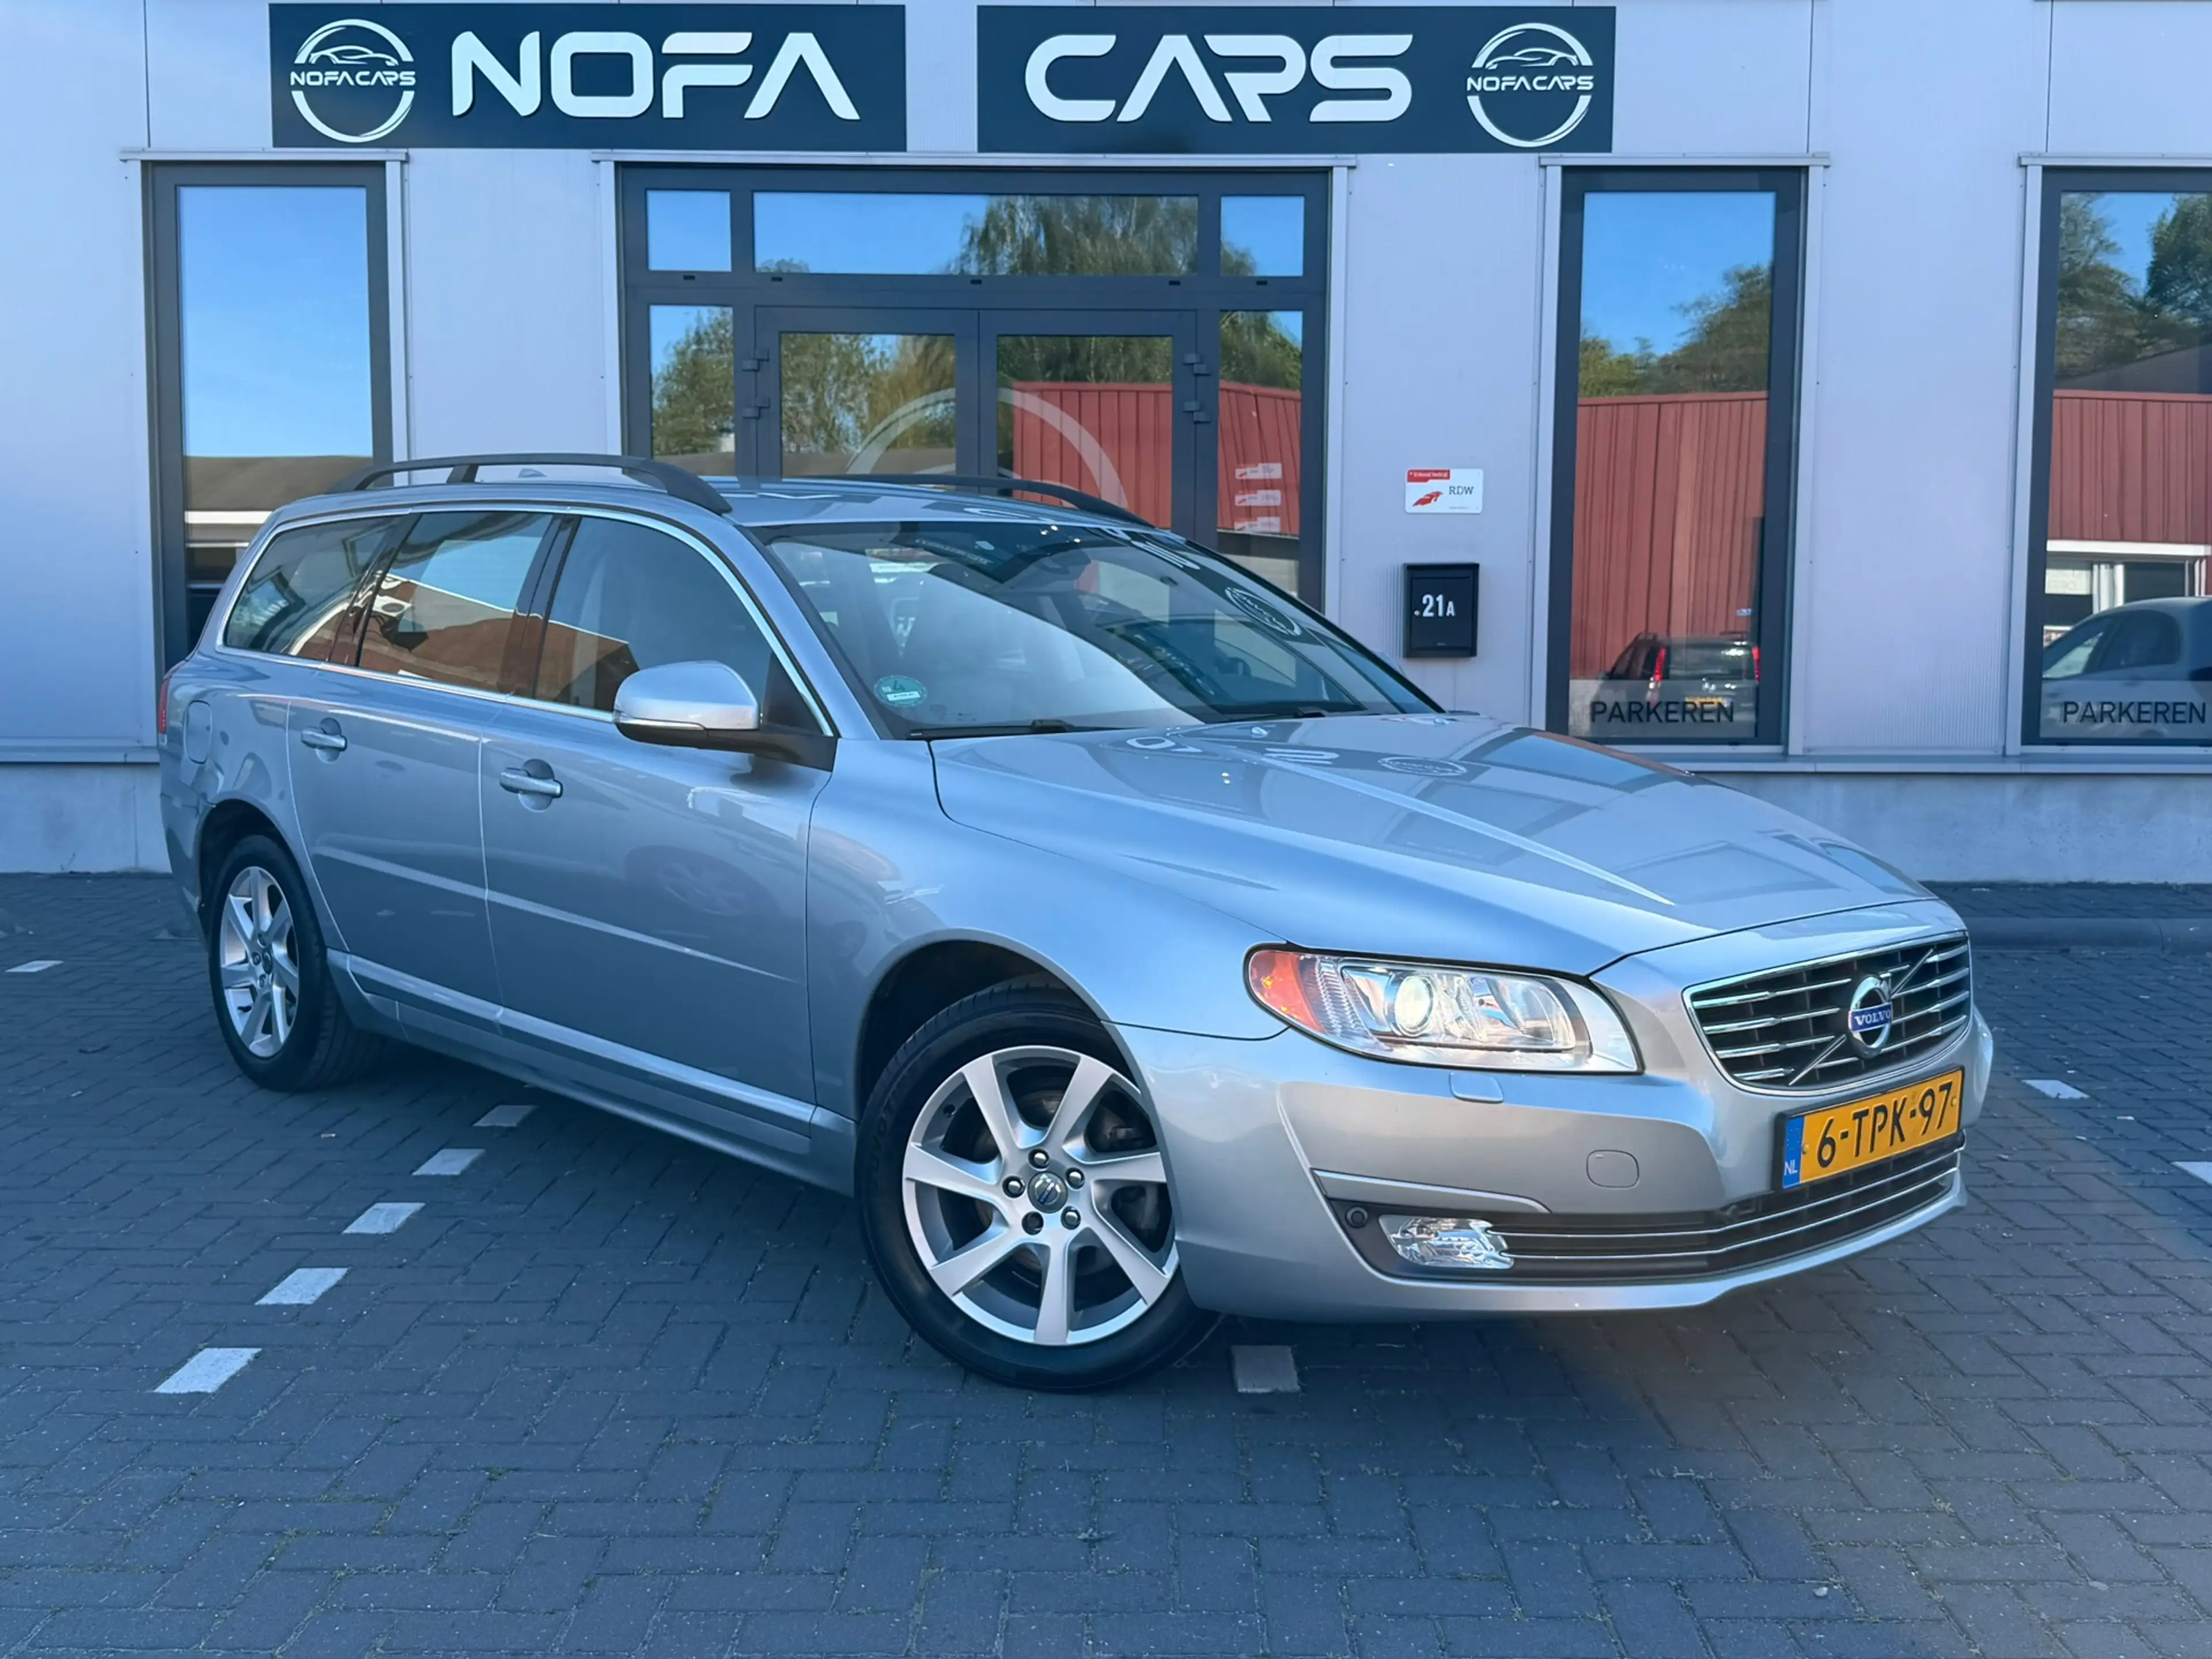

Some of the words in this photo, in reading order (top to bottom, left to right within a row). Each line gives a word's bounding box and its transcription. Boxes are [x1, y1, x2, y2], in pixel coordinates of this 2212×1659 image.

[451, 31, 861, 120] NOFA
[1024, 34, 1414, 123] CARS
[1448, 486, 1474, 495] RDW
[1589, 701, 1734, 723] PARKEREN
[2062, 700, 2207, 724] PARKEREN
[1854, 1009, 1892, 1026] VOLVO
[1817, 1081, 1953, 1168] 6-TPK-97
[1783, 1159, 1798, 1176] NL
